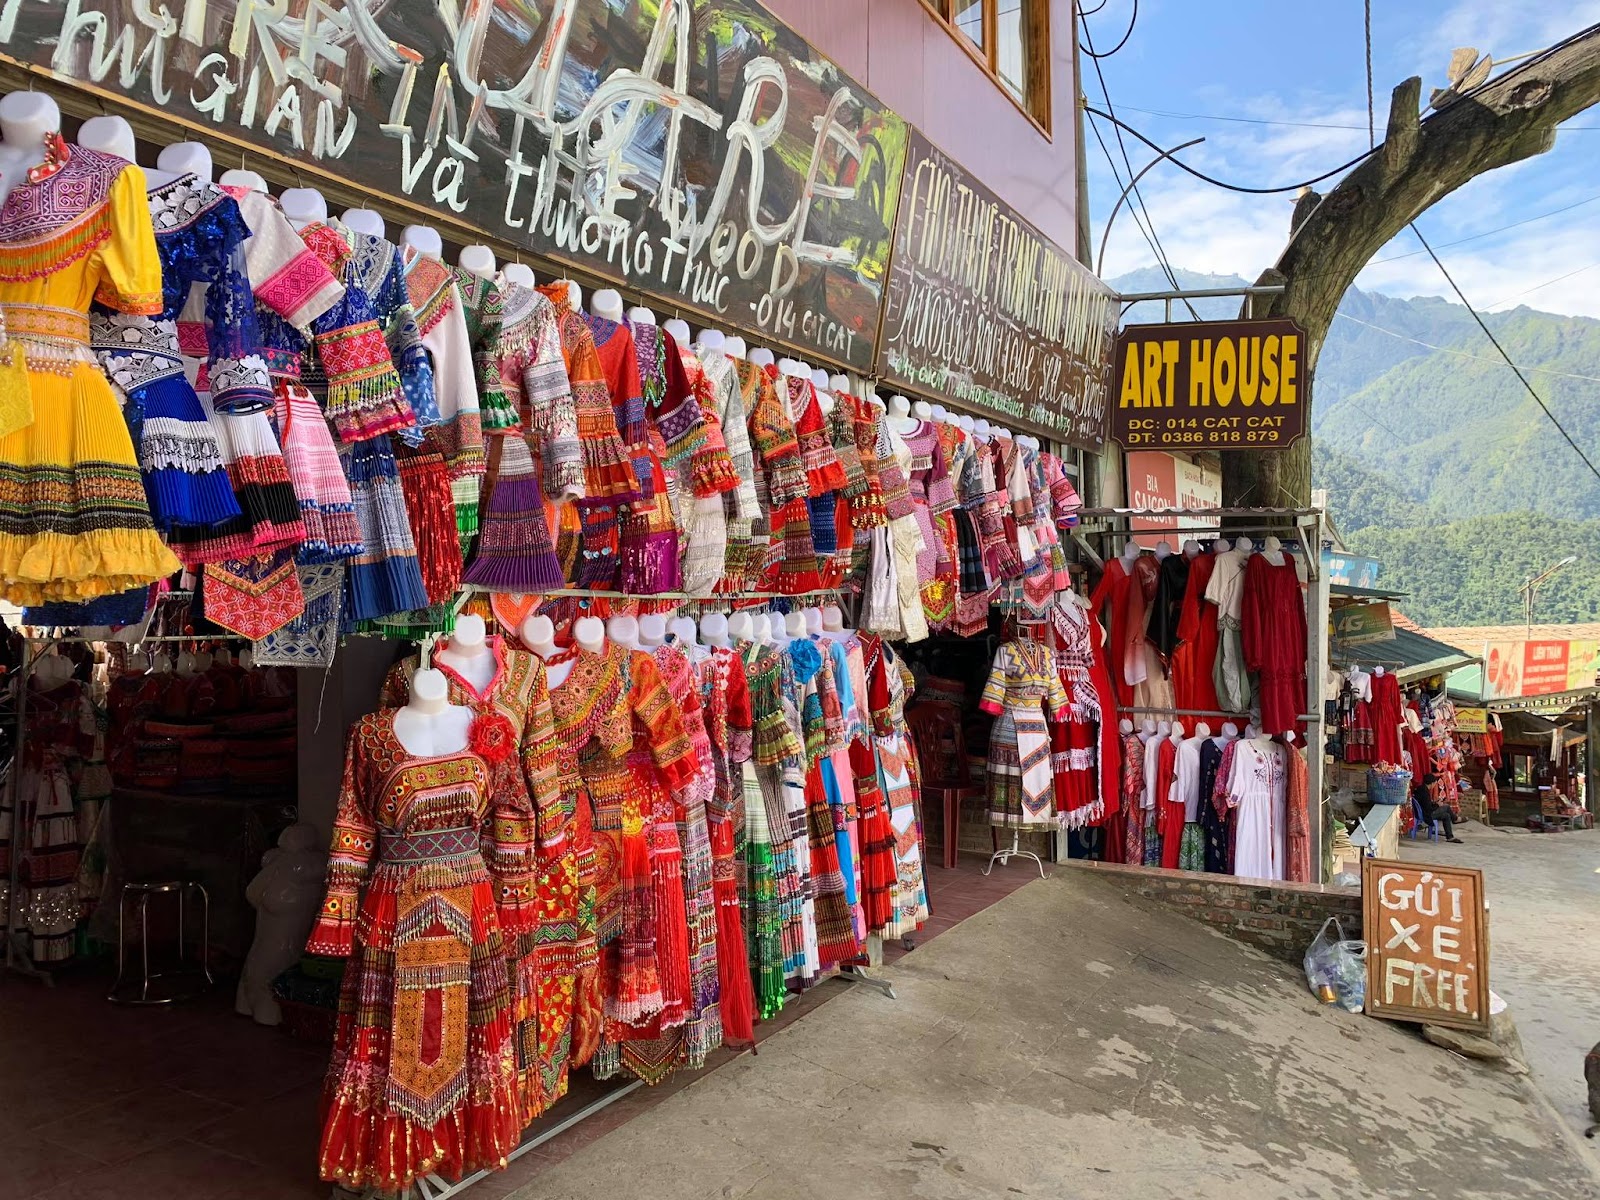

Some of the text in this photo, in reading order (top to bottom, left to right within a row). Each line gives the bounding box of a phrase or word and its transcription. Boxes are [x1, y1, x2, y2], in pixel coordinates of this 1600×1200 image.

[906, 157, 951, 273] CHO
[1119, 334, 1298, 409] ART HOUSE
[1128, 416, 1285, 430] ĐC: 014 CAT CAT
[1128, 430, 1280, 444] ĐT: 0386 818 879
[1146, 474, 1158, 493] BIA
[1134, 490, 1172, 524] SAIGON
[1385, 917, 1461, 963] XE
[1385, 957, 1469, 1013] FREE
